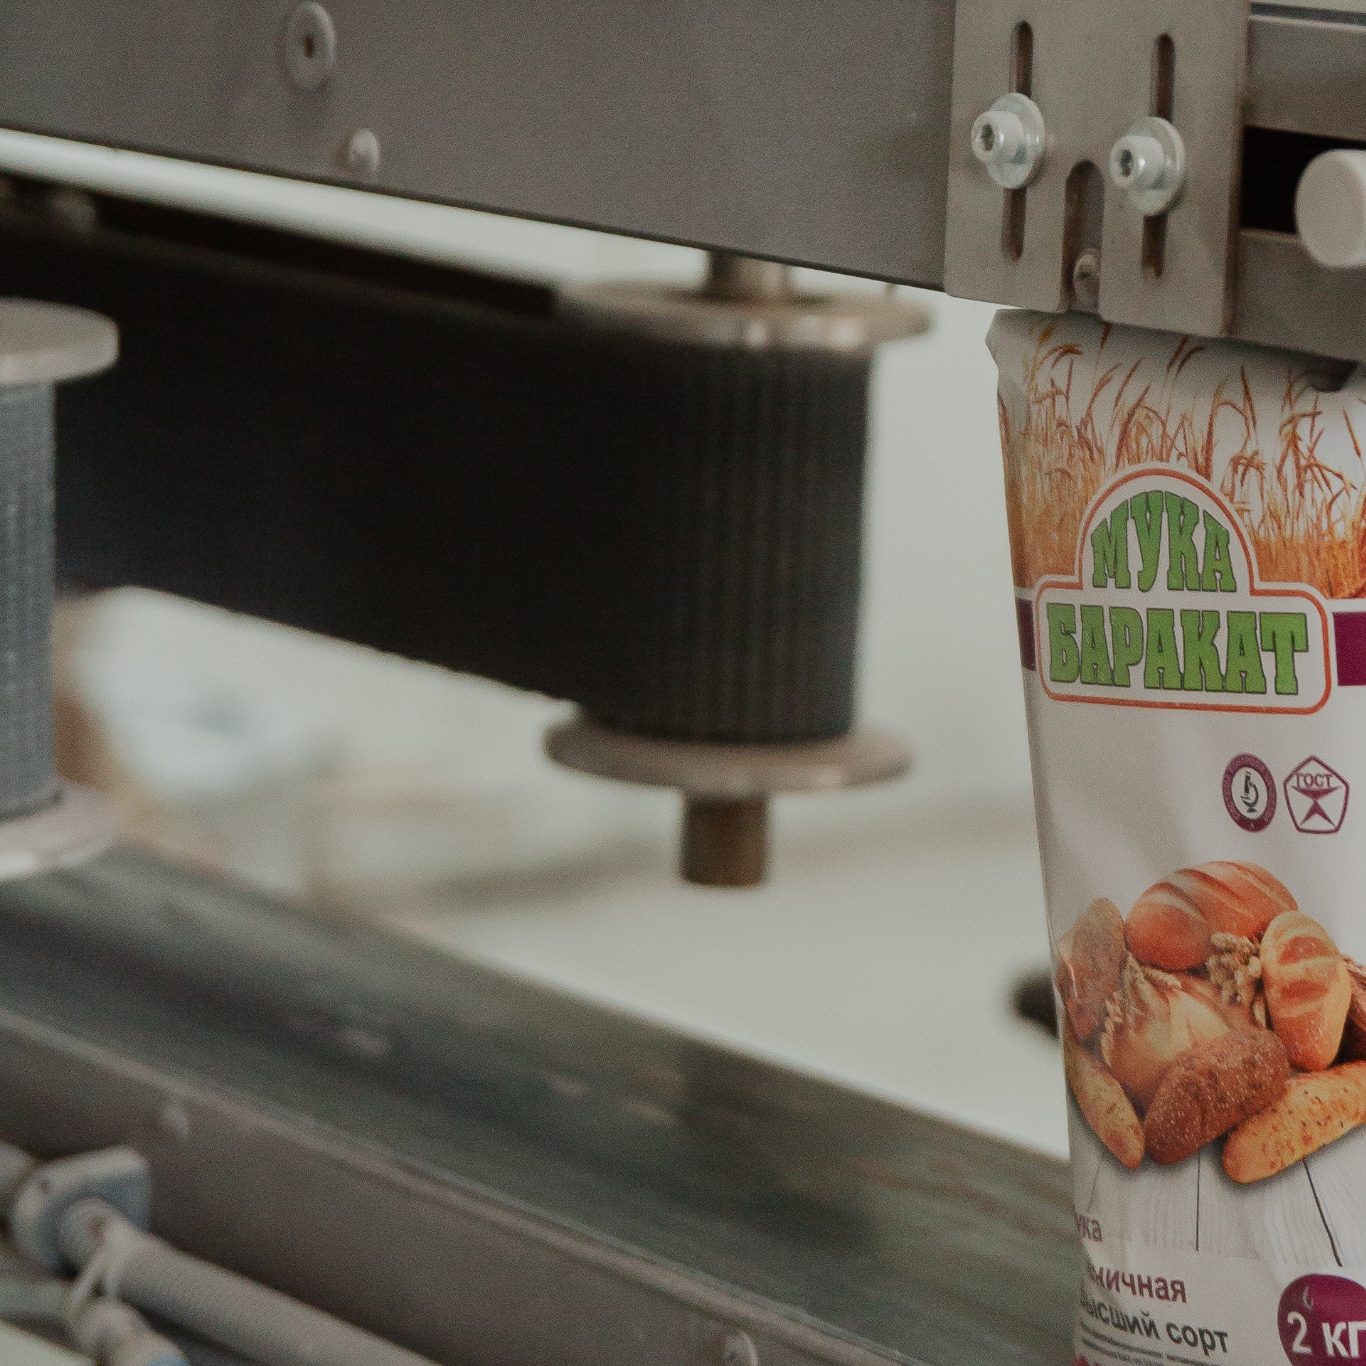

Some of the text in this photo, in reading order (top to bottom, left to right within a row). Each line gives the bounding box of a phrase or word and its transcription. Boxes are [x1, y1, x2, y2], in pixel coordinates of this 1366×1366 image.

[1090, 490, 1237, 593] МУКА
[1046, 602, 1309, 696] БАРАКАТ
[1294, 773, 1334, 789] ГОСТ
[1166, 1321, 1229, 1356] сорт
[1287, 1311, 1313, 1355] 2
